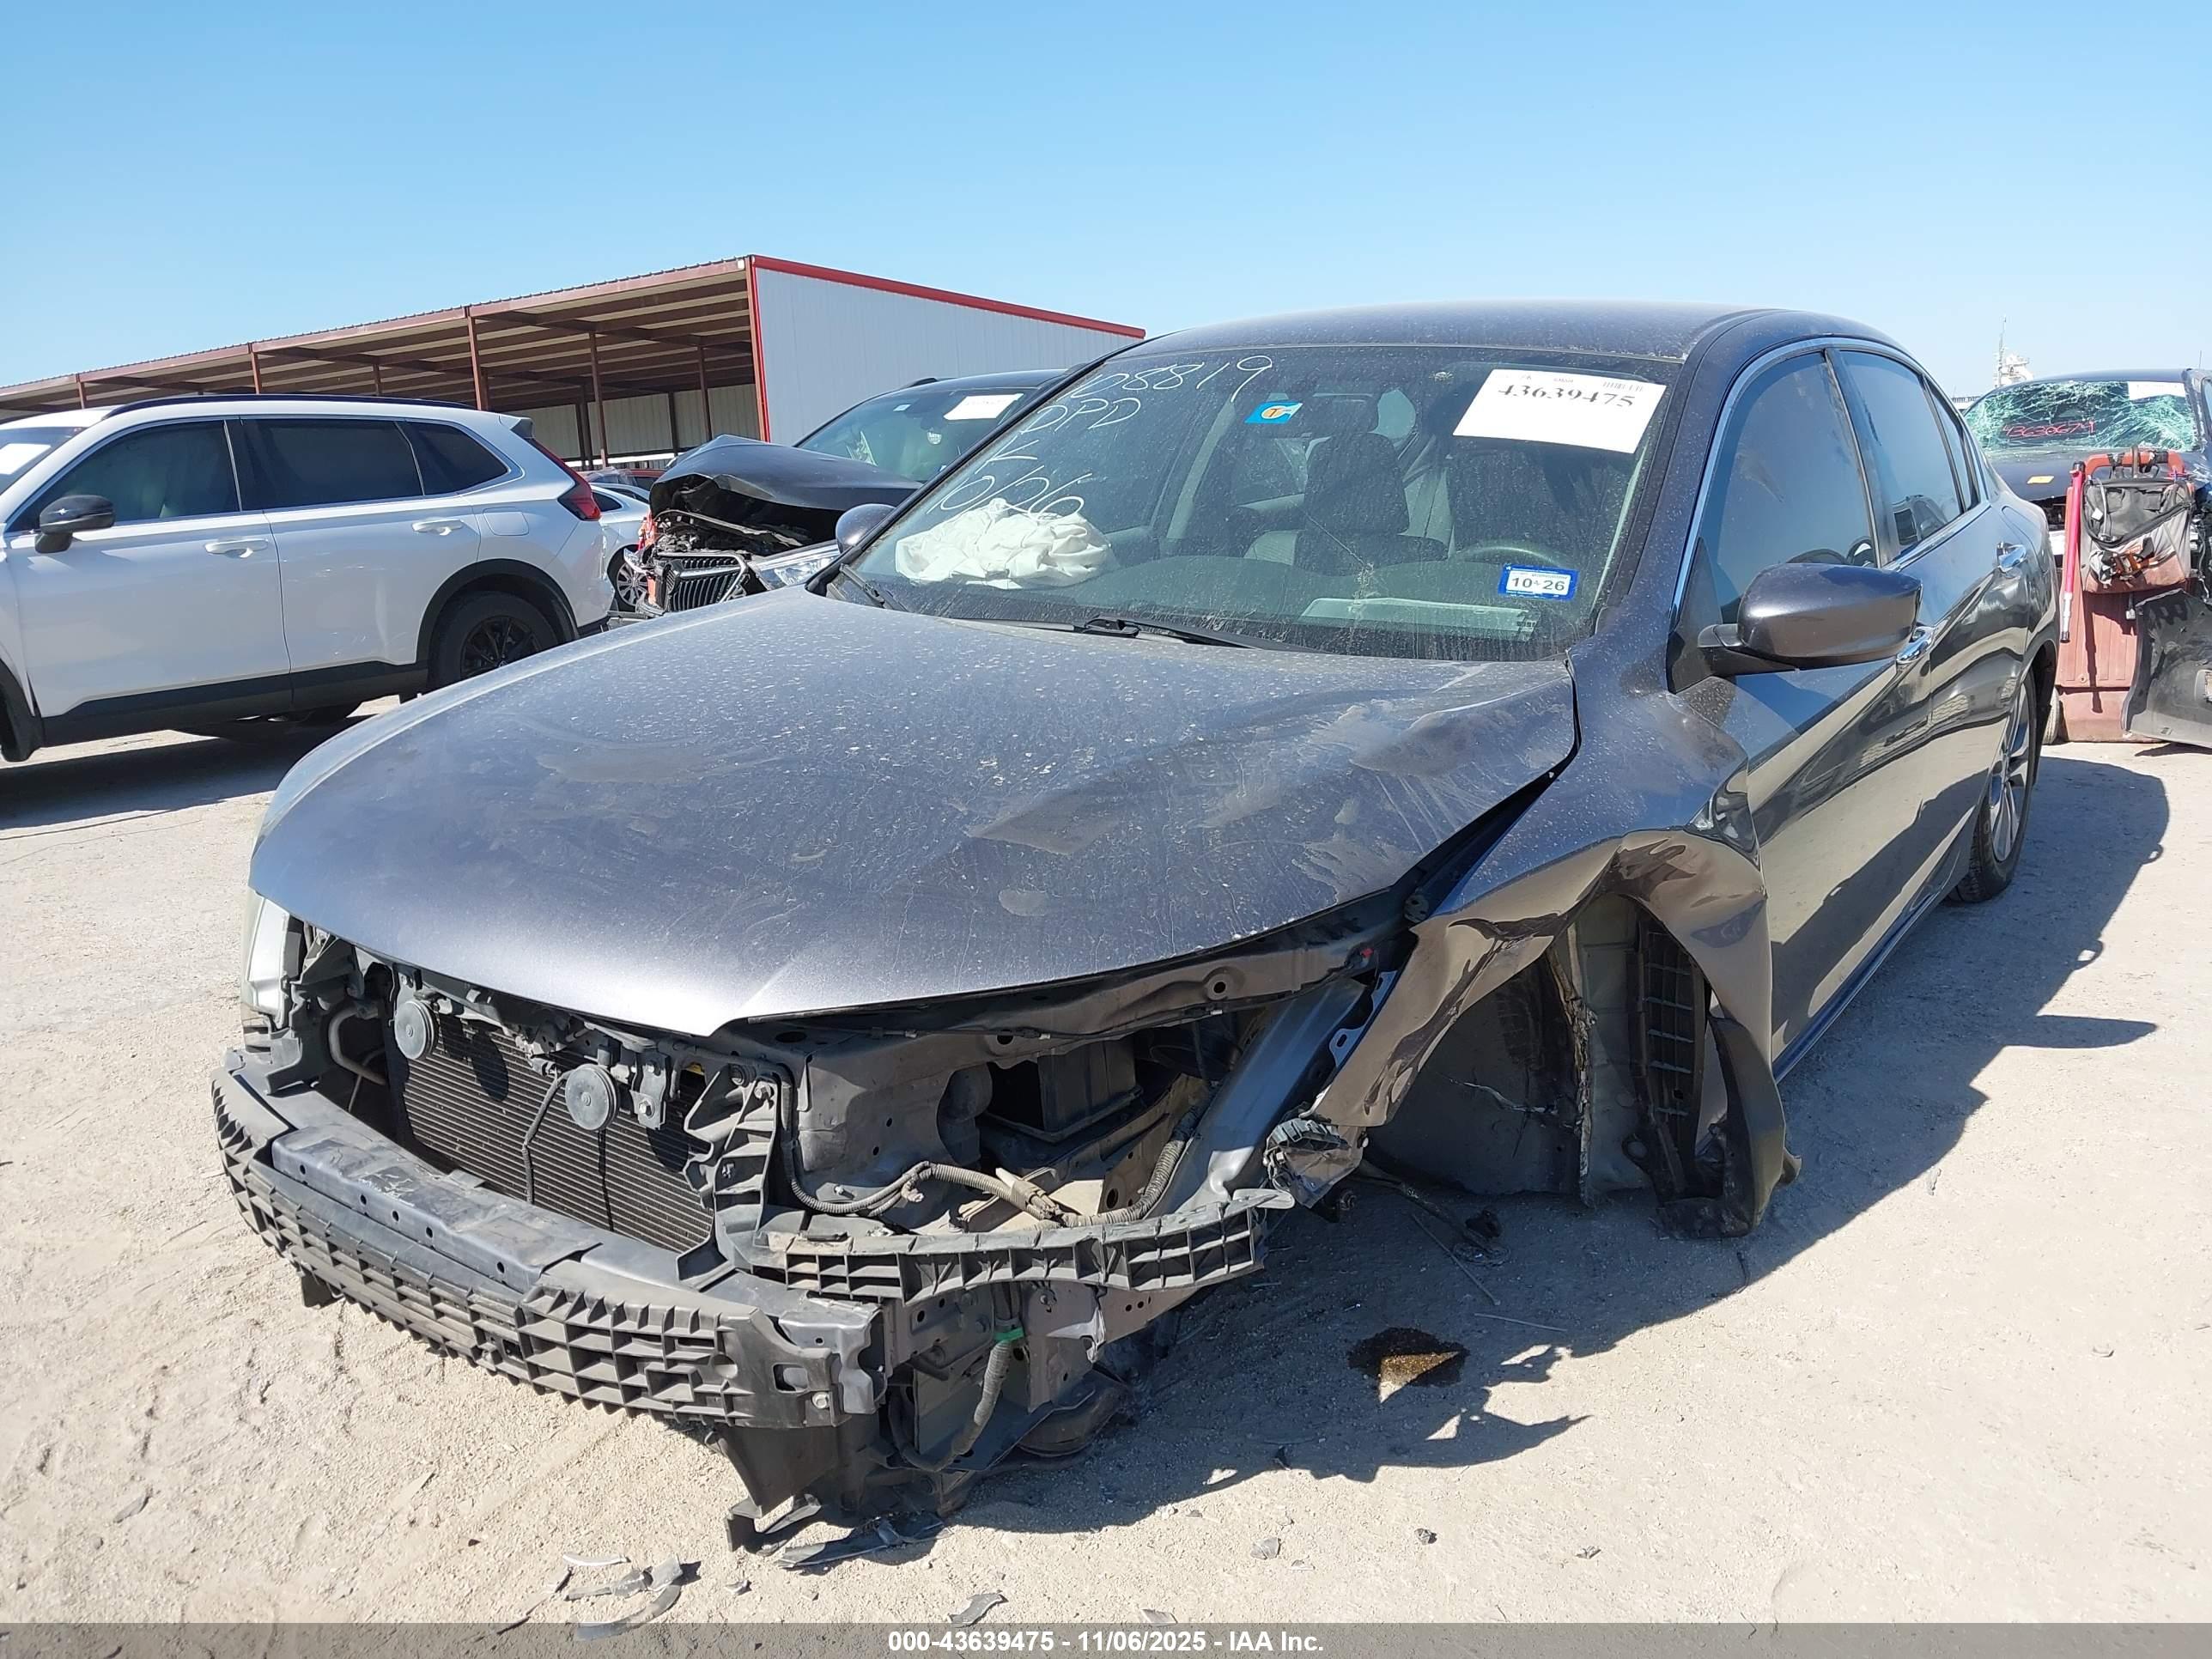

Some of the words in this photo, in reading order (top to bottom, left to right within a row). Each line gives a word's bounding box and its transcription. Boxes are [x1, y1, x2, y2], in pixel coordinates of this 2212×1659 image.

[1498, 385, 1635, 406] 43639475
[1019, 397, 1141, 435] DPD
[1511, 576, 1533, 588] 10
[1542, 579, 1565, 592] 26
